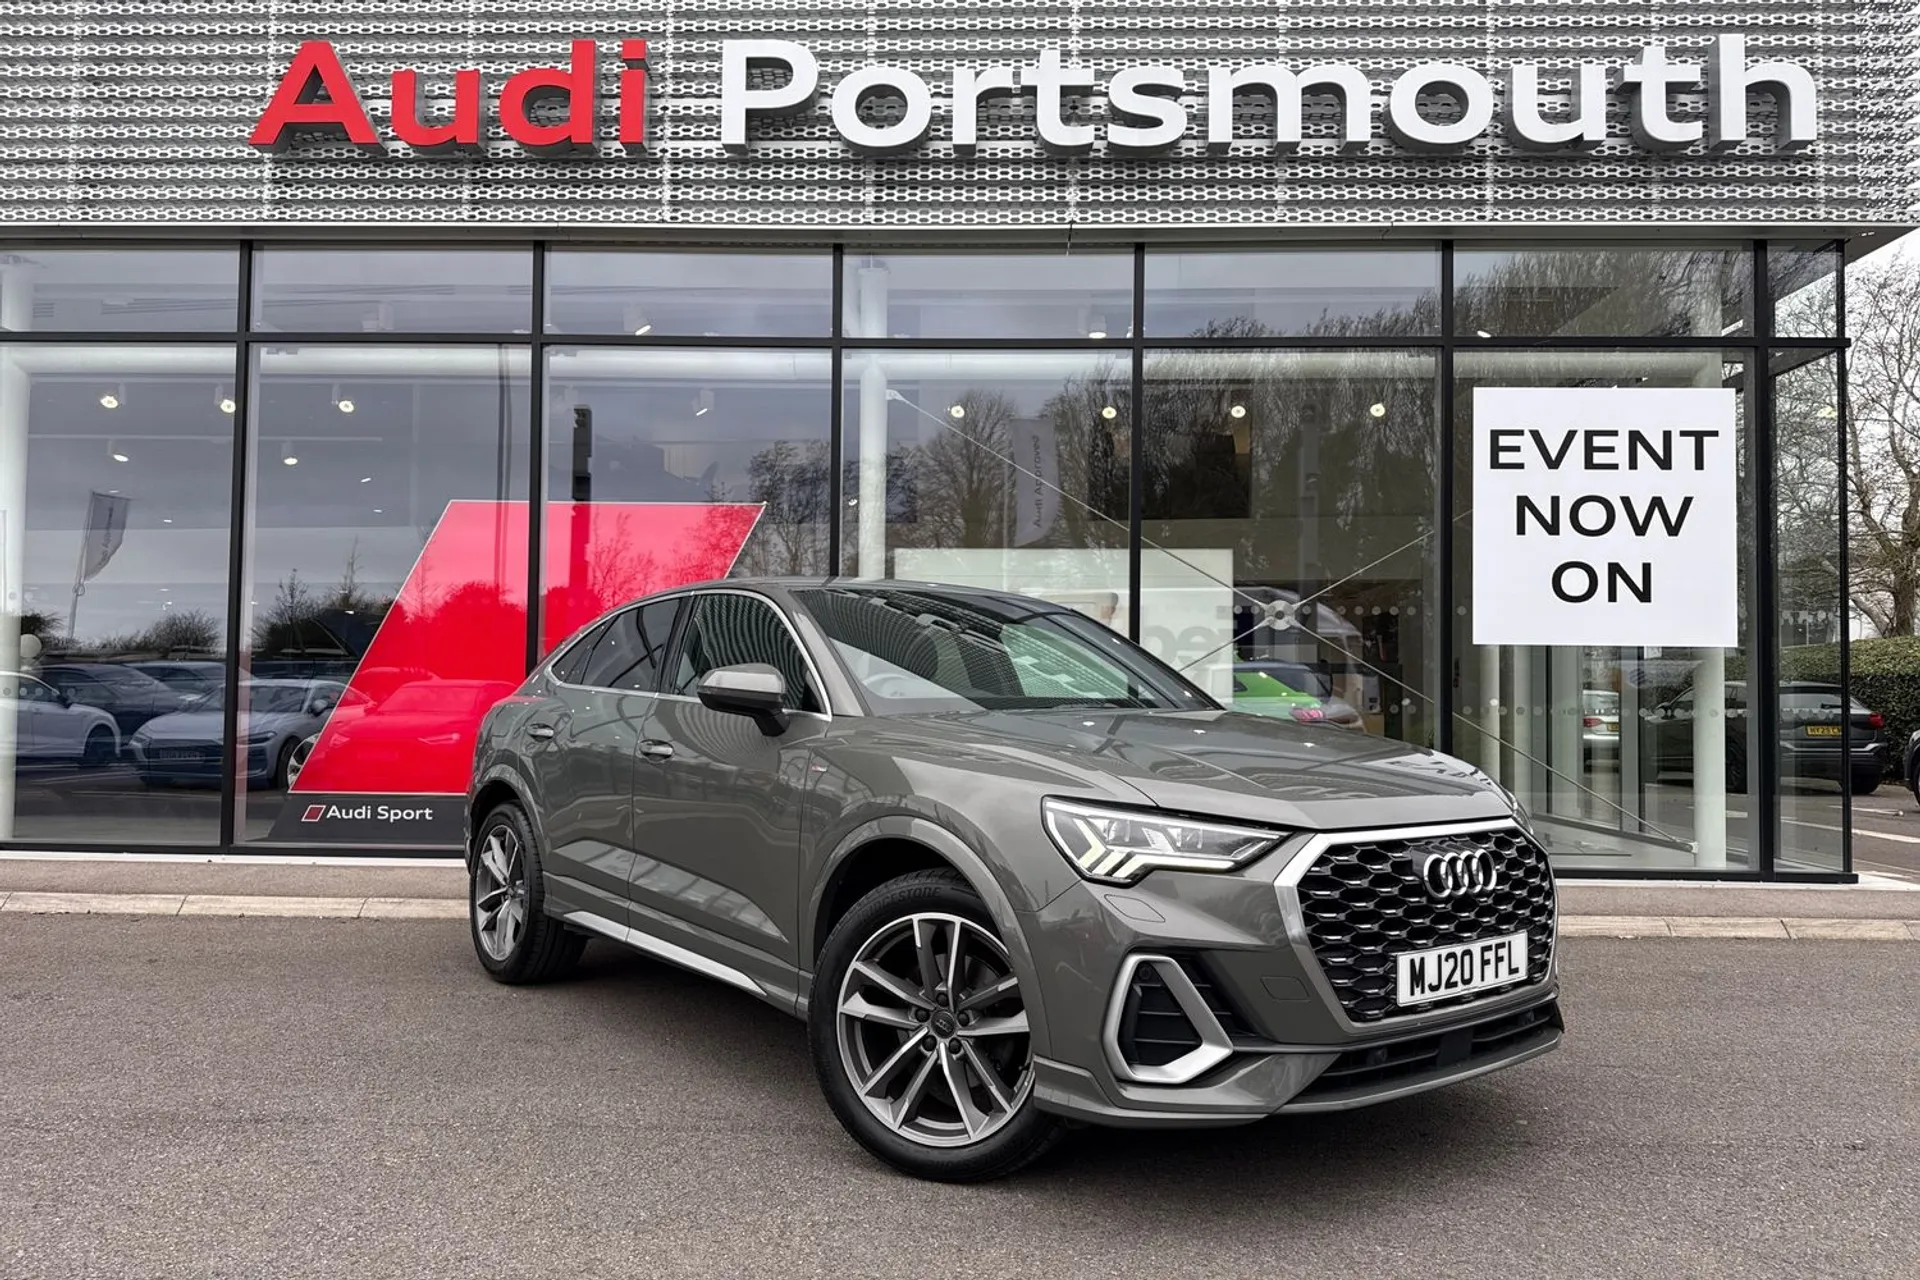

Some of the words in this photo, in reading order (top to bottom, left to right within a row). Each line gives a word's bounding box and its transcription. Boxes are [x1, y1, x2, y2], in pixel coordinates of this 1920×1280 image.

[249, 40, 647, 146] Audi
[721, 34, 1818, 148] Portsmouth
[1490, 429, 1719, 470] EVENT
[1516, 495, 1694, 537] NOW
[1551, 561, 1651, 604] ON
[326, 805, 372, 820] Audi
[377, 806, 433, 823] Sport
[1409, 948, 1474, 997] MJ20
[1480, 940, 1520, 982] FFL
